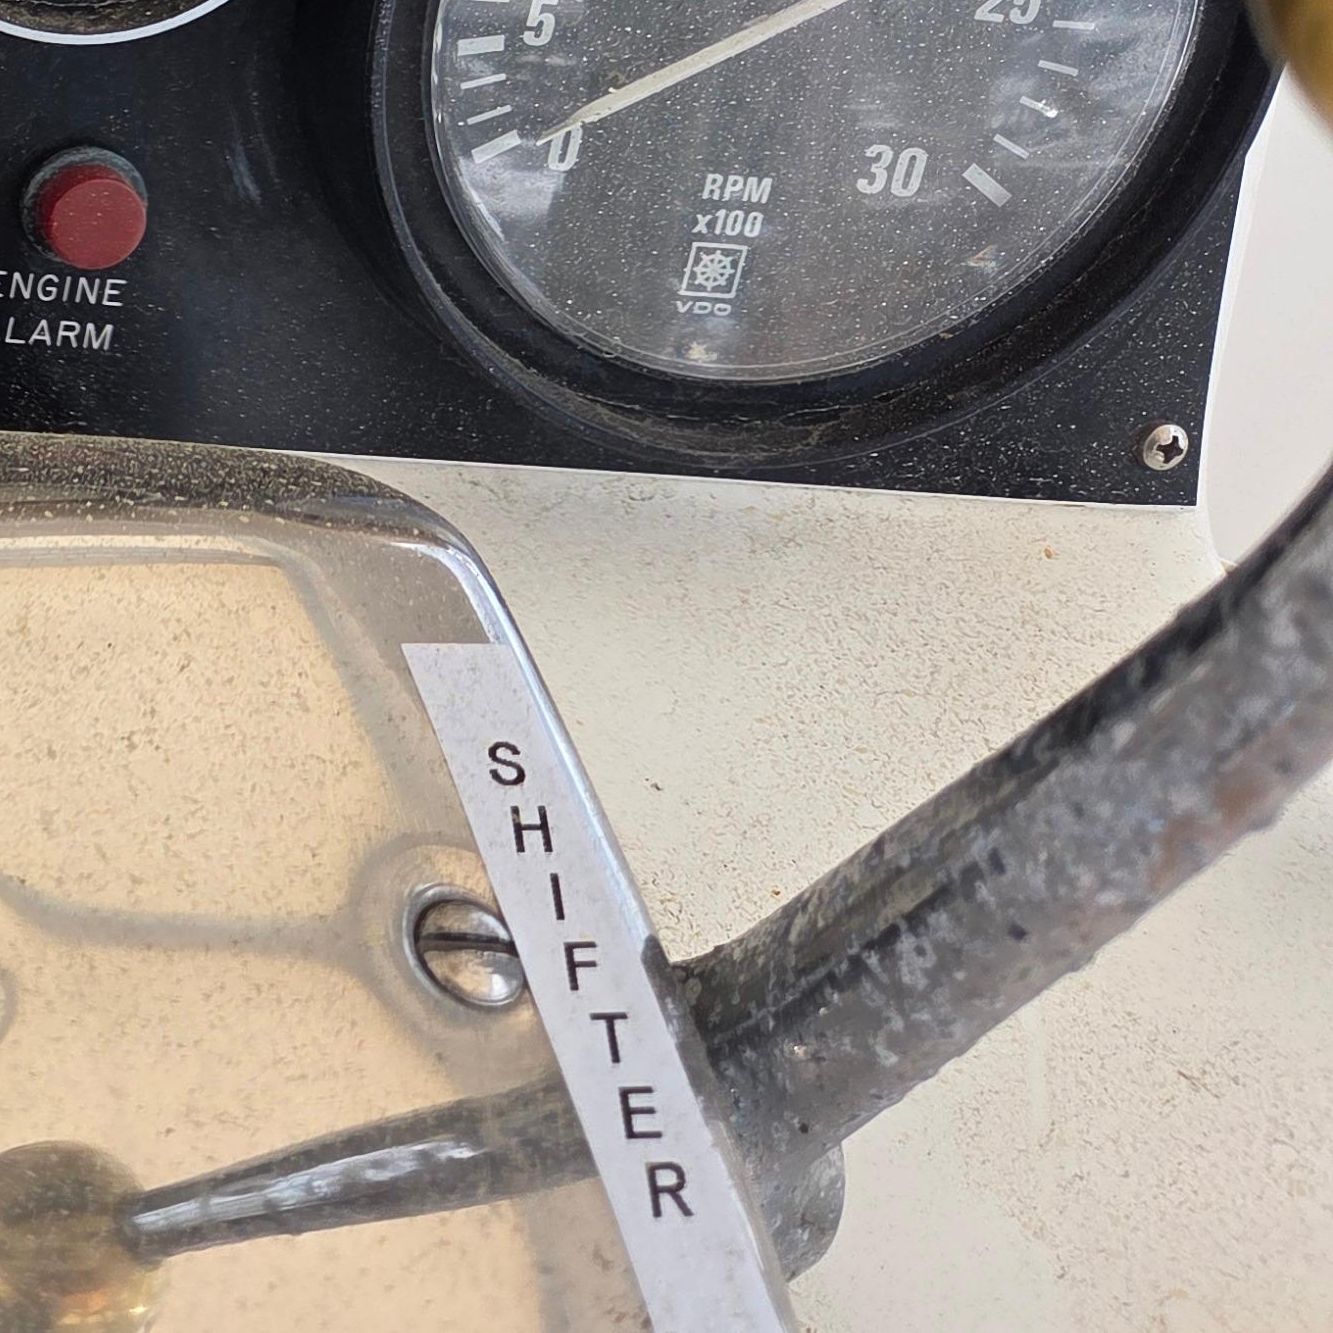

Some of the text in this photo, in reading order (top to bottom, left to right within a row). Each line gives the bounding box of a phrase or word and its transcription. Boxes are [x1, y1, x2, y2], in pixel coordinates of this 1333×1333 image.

[547, 121, 584, 172] 0
[701, 172, 773, 204] RPM
[855, 144, 929, 199] 30
[690, 208, 765, 238] x100
[674, 300, 732, 317] VDO
[486, 740, 695, 1220] SHIFTER
